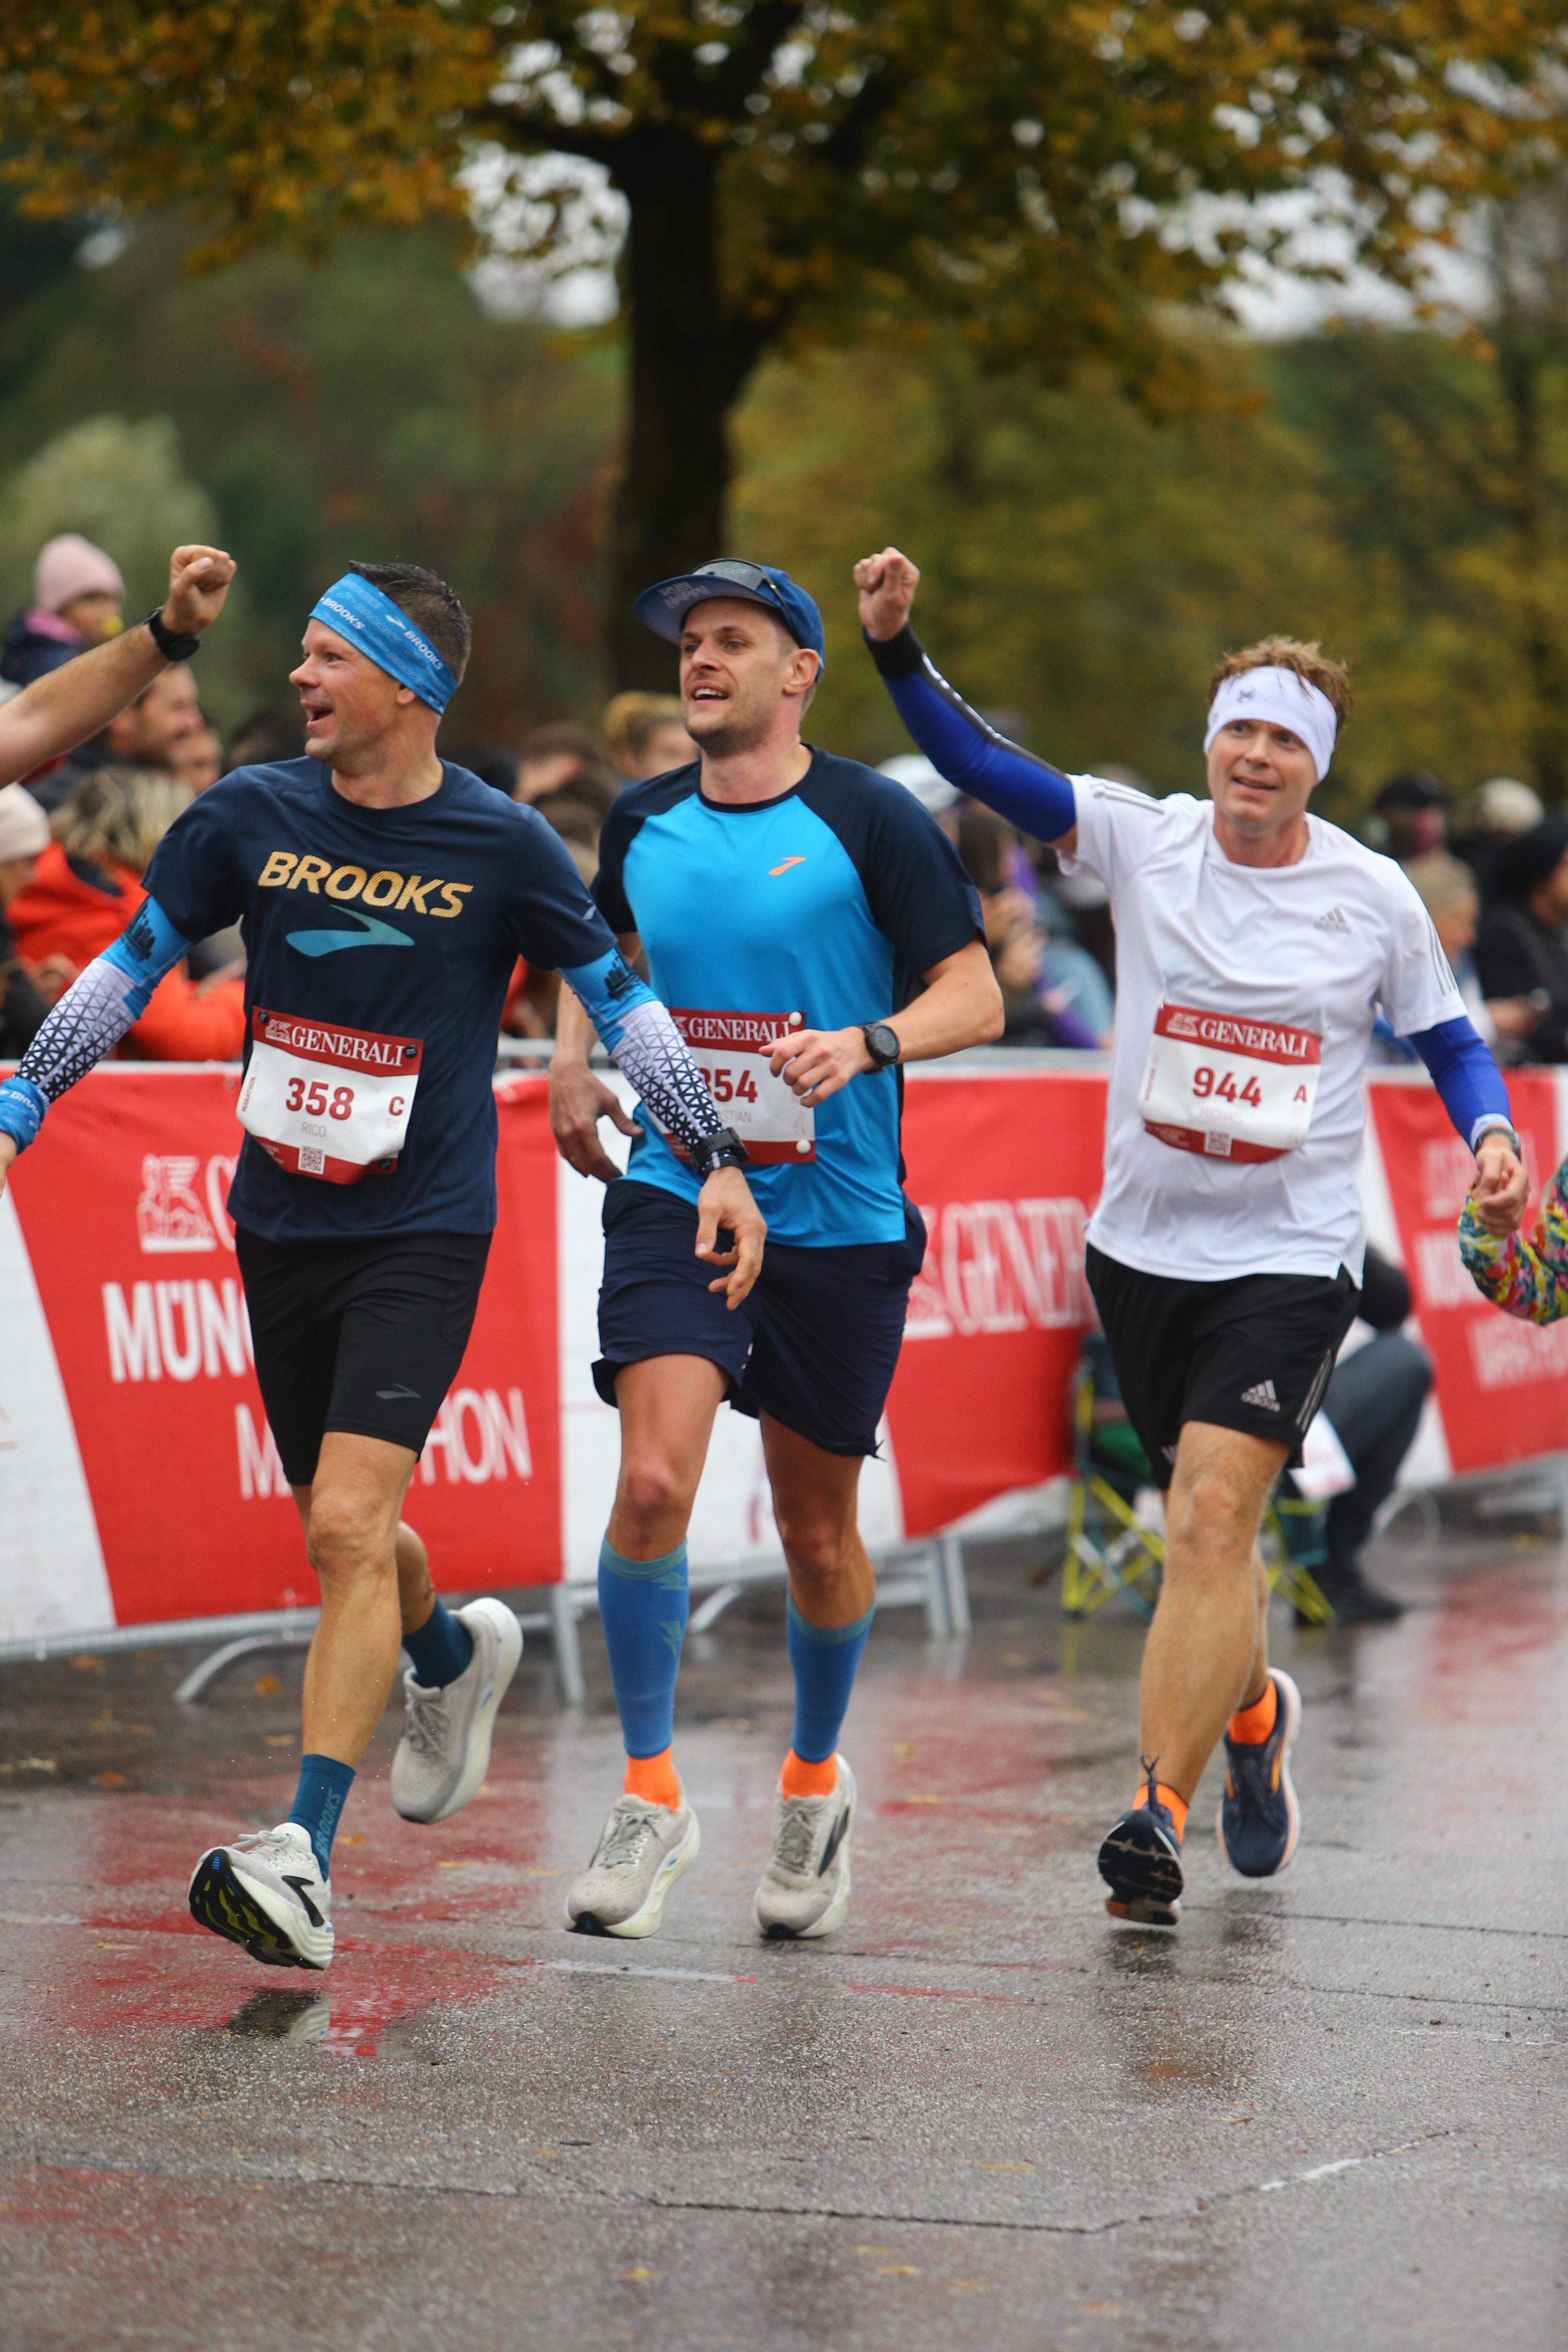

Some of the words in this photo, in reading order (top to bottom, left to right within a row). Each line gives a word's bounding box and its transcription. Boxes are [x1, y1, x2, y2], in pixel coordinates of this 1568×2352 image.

[322, 597, 364, 629] BROOKS
[404, 630, 444, 670] BROOKS
[258, 850, 474, 918] BROOKS
[291, 1025, 405, 1067] GENERALI
[1200, 1018, 1309, 1058] GENERALI
[286, 1077, 354, 1120] 358
[388, 1096, 405, 1116] C
[1193, 1065, 1262, 1108] 944
[1293, 1083, 1308, 1103] A
[302, 1122, 327, 1138] RICO
[315, 1787, 341, 1862] BROOKS
